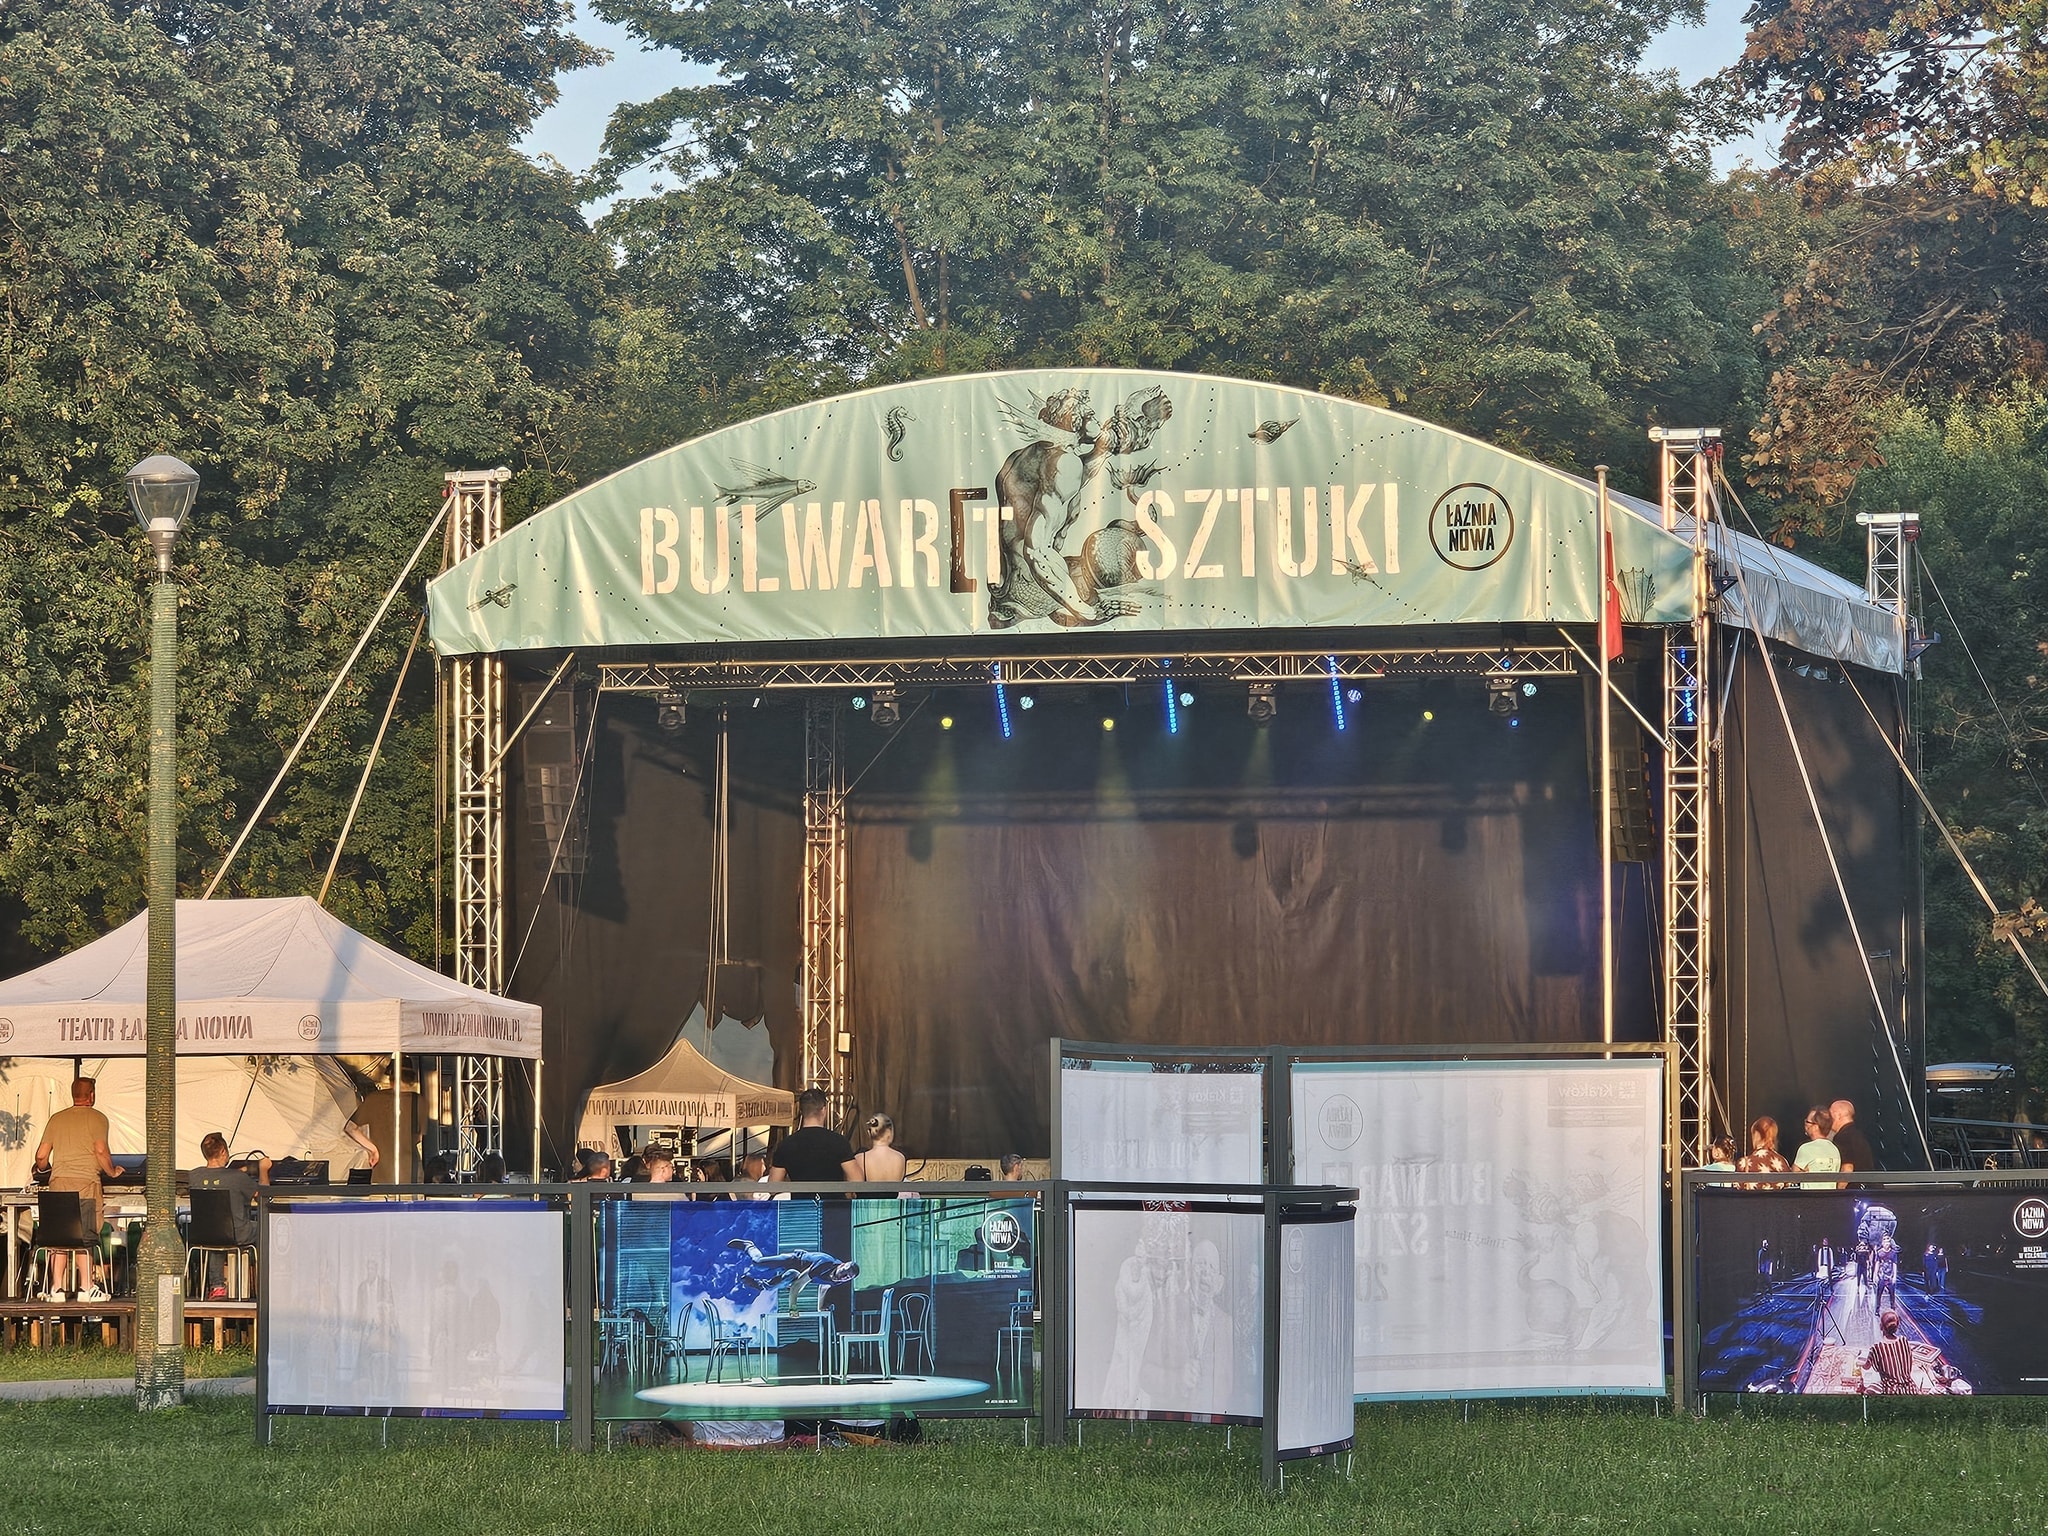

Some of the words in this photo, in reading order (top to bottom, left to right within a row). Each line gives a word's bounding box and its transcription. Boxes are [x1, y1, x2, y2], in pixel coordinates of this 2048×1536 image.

[1446, 501, 1497, 527] ŁAŹNIA
[1135, 483, 1400, 581] SZTUKI
[1449, 527, 1495, 552] NOWA
[58, 1017, 116, 1042] TEATR
[119, 1017, 188, 1042] ŁAA
[194, 1015, 253, 1041] NOWA
[2022, 1219, 2044, 1230] NOWA
[990, 1232, 1012, 1244] NOWA
